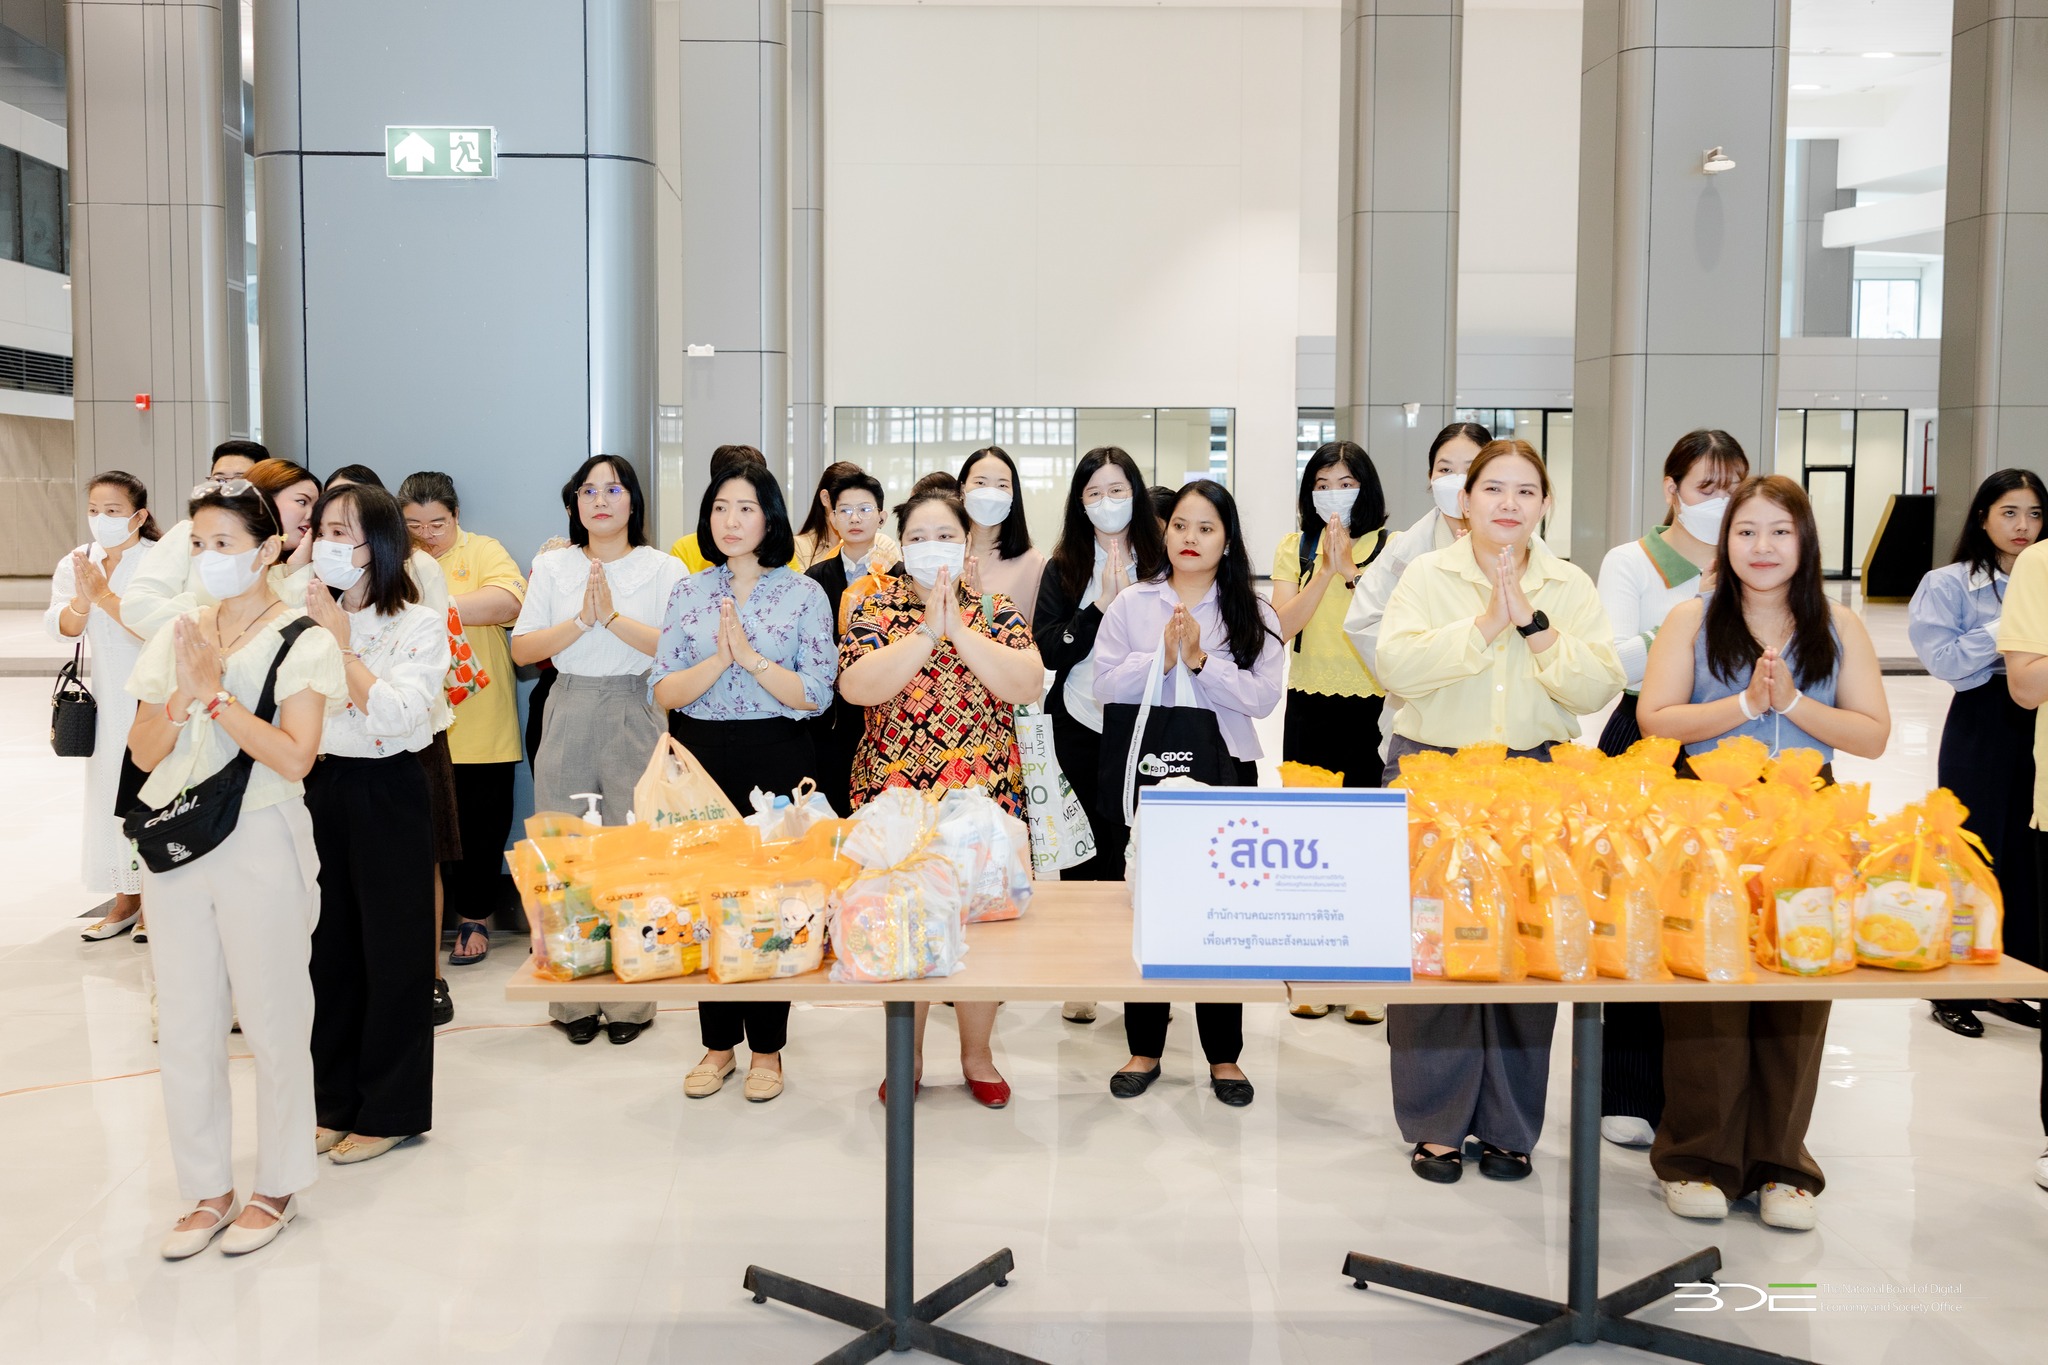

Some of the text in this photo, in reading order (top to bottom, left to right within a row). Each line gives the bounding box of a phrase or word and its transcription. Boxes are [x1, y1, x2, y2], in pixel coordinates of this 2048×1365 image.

[1019, 741, 1034, 755] SH
[1036, 724, 1046, 759] MEATY
[1160, 751, 1194, 762] GDCC
[1021, 762, 1047, 777] SPY
[1169, 764, 1191, 773] Data
[1024, 785, 1049, 805] RO
[1062, 799, 1081, 822] MEAT
[1030, 833, 1046, 847] SH
[1074, 832, 1096, 858] QU
[1032, 850, 1060, 867] SPY
[1230, 838, 1329, 869] สดช.
[1206, 908, 1345, 922] สำนักงานคณะกรรมการดิจิทัล
[1202, 930, 1350, 950] เพื่อเศรษฐกิจและสังคมแห่งชาติ
